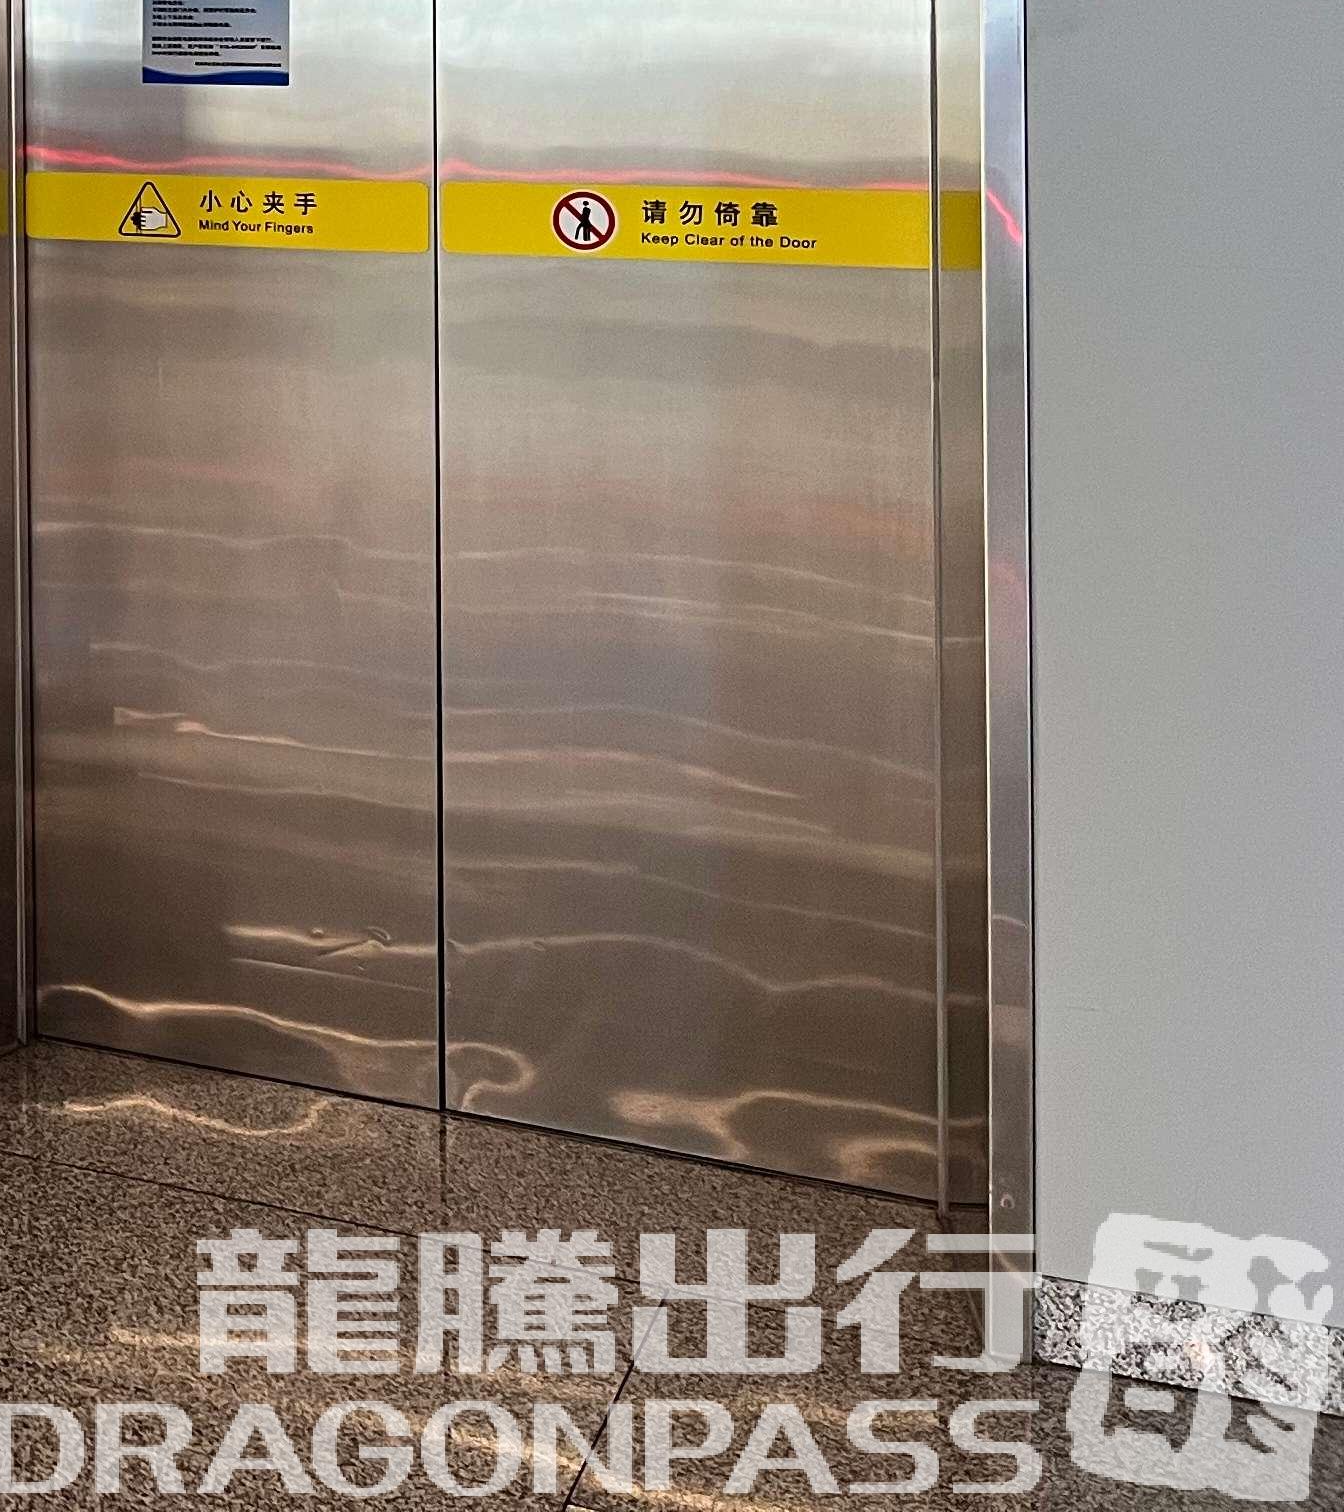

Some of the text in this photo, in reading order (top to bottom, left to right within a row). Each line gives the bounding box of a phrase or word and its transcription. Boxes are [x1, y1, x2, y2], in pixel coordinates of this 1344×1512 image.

[198, 188, 318, 216] 小心夹手
[641, 199, 779, 228] 请勿倚靠
[198, 219, 314, 235] Mind Your Fingers
[641, 232, 817, 250] Keep Clear of the Door
